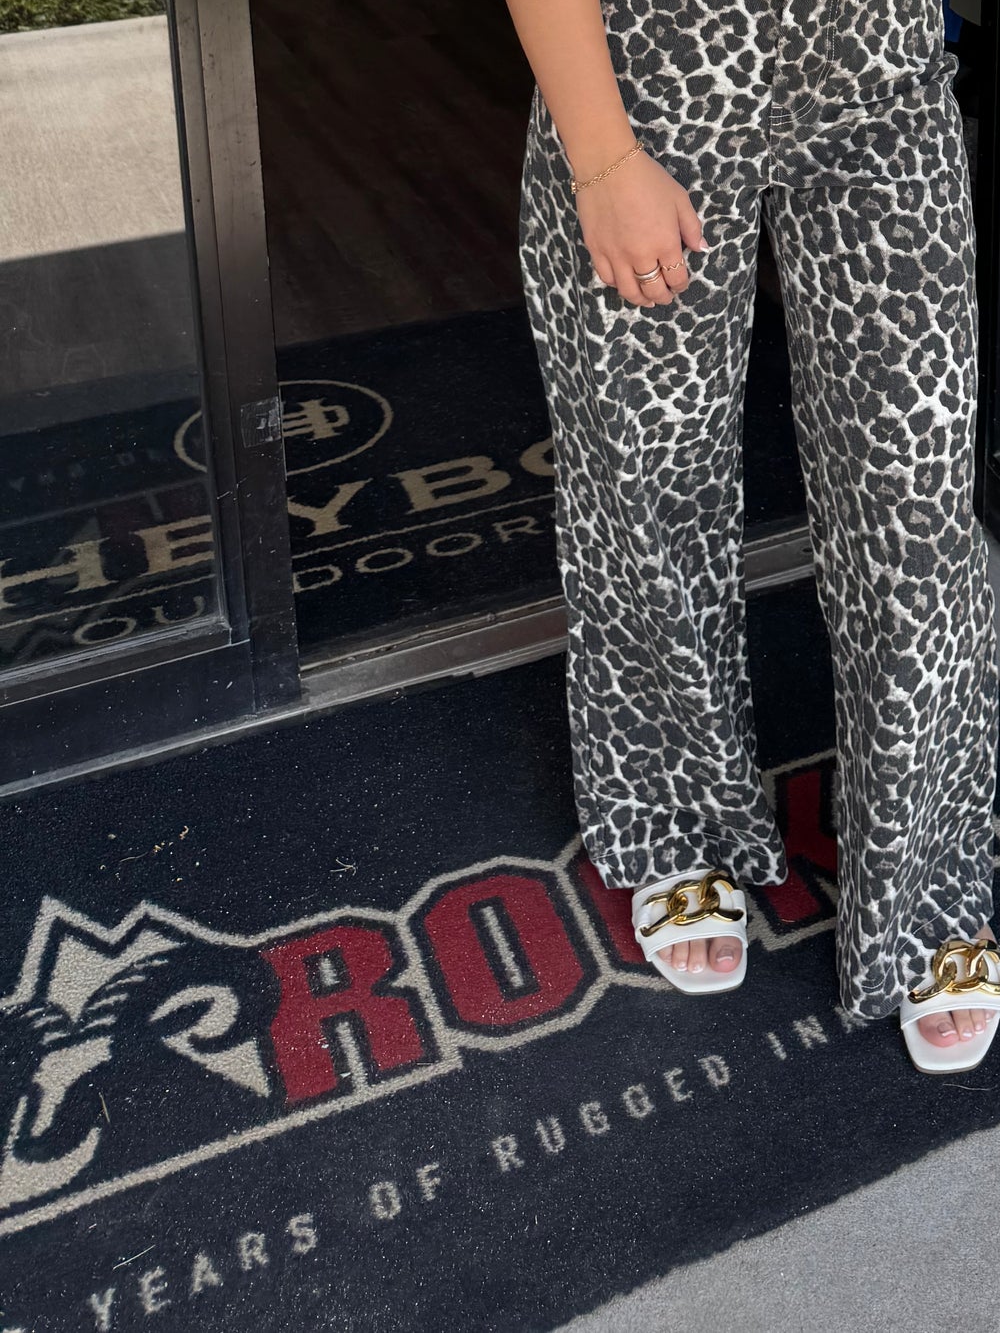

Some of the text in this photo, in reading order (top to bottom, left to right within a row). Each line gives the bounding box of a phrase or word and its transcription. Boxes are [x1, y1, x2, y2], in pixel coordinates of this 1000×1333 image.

[89, 1212, 318, 1333] YEARS
[367, 1161, 441, 1221] OF
[491, 1053, 731, 1172] RUGGED
